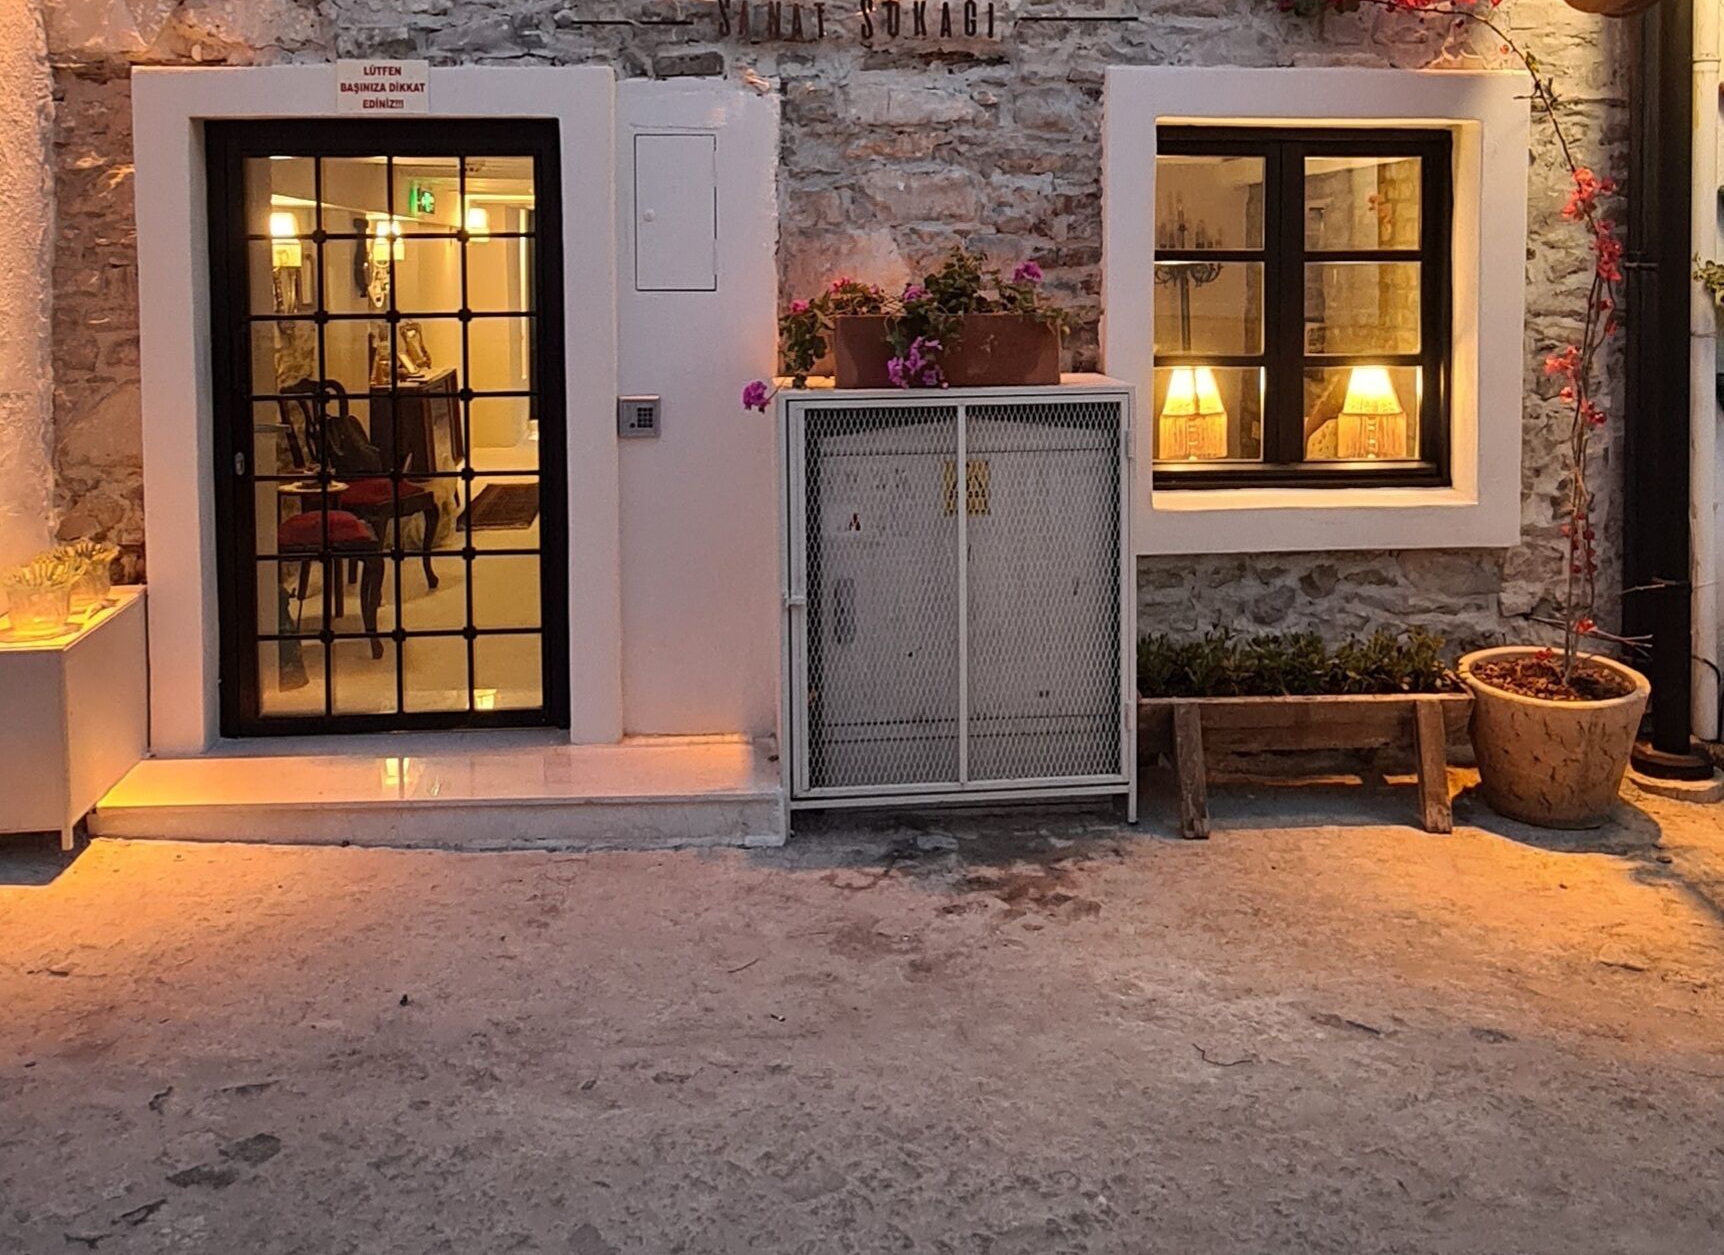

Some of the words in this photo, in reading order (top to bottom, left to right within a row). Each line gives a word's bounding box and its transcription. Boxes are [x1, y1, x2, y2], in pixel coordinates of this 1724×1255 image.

[363, 65, 402, 76] LÜTFEN
[340, 82, 386, 94] BAŞINIZA
[389, 81, 426, 92] DİKKAT
